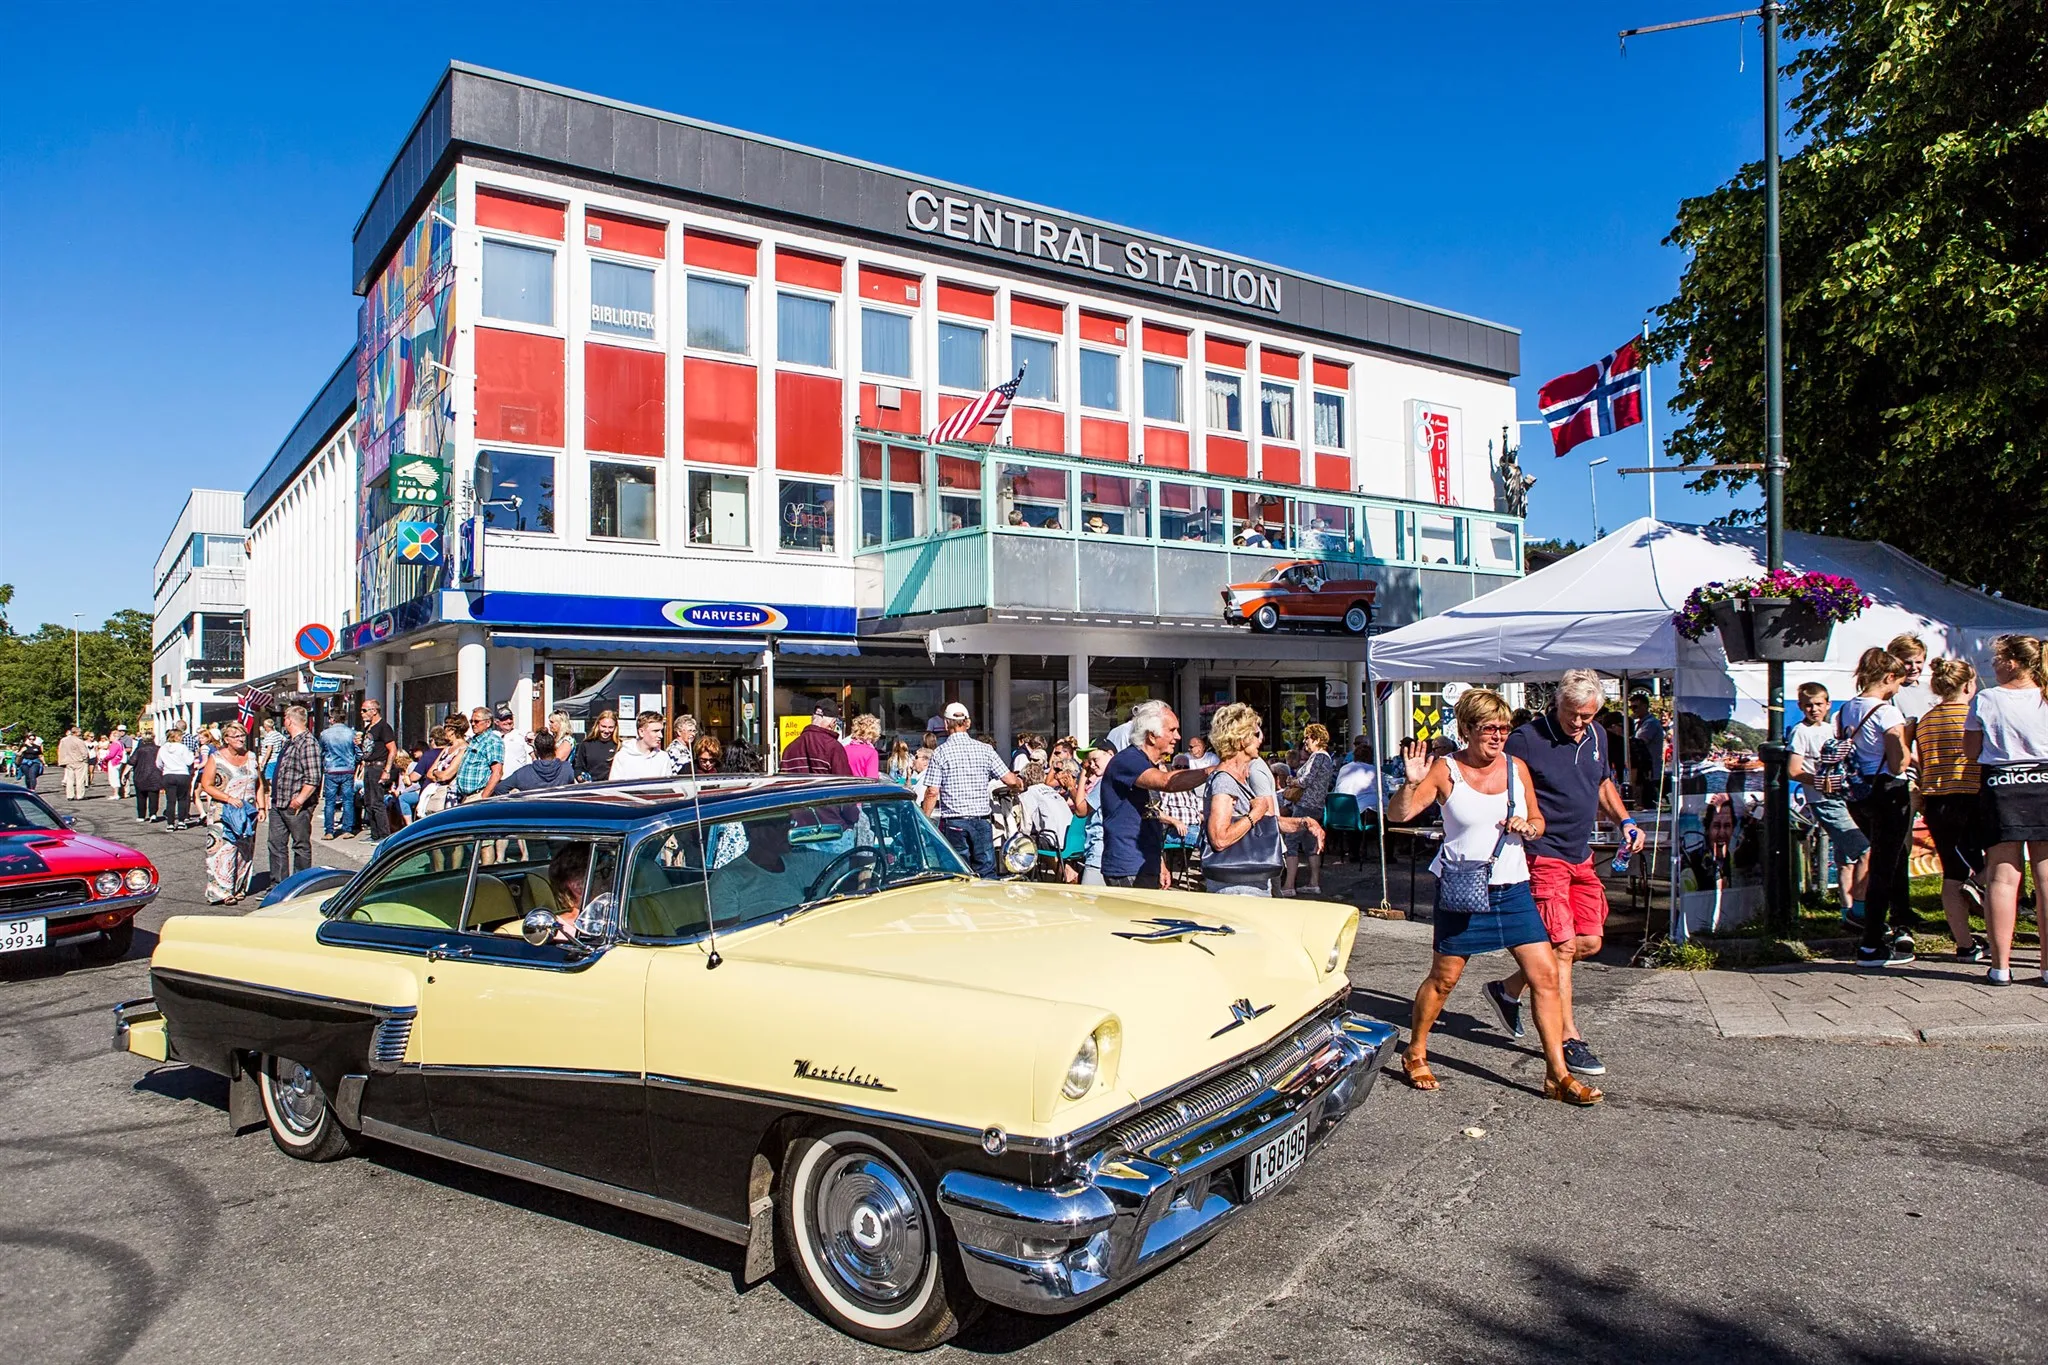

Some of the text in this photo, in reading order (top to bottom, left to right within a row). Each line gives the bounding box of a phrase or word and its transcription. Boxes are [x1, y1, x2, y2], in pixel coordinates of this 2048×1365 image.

[907, 189, 1281, 312] CENTRAL STATION
[592, 304, 655, 329] BIBLIOTEK
[1437, 438, 1447, 505] DINER
[397, 486, 437, 501] TOTO
[692, 609, 760, 622] NARVESEN
[785, 721, 798, 729] Alle
[1987, 772, 2048, 788] adidas
[10, 921, 28, 935] SD
[1253, 1123, 1306, 1188] A-88196
